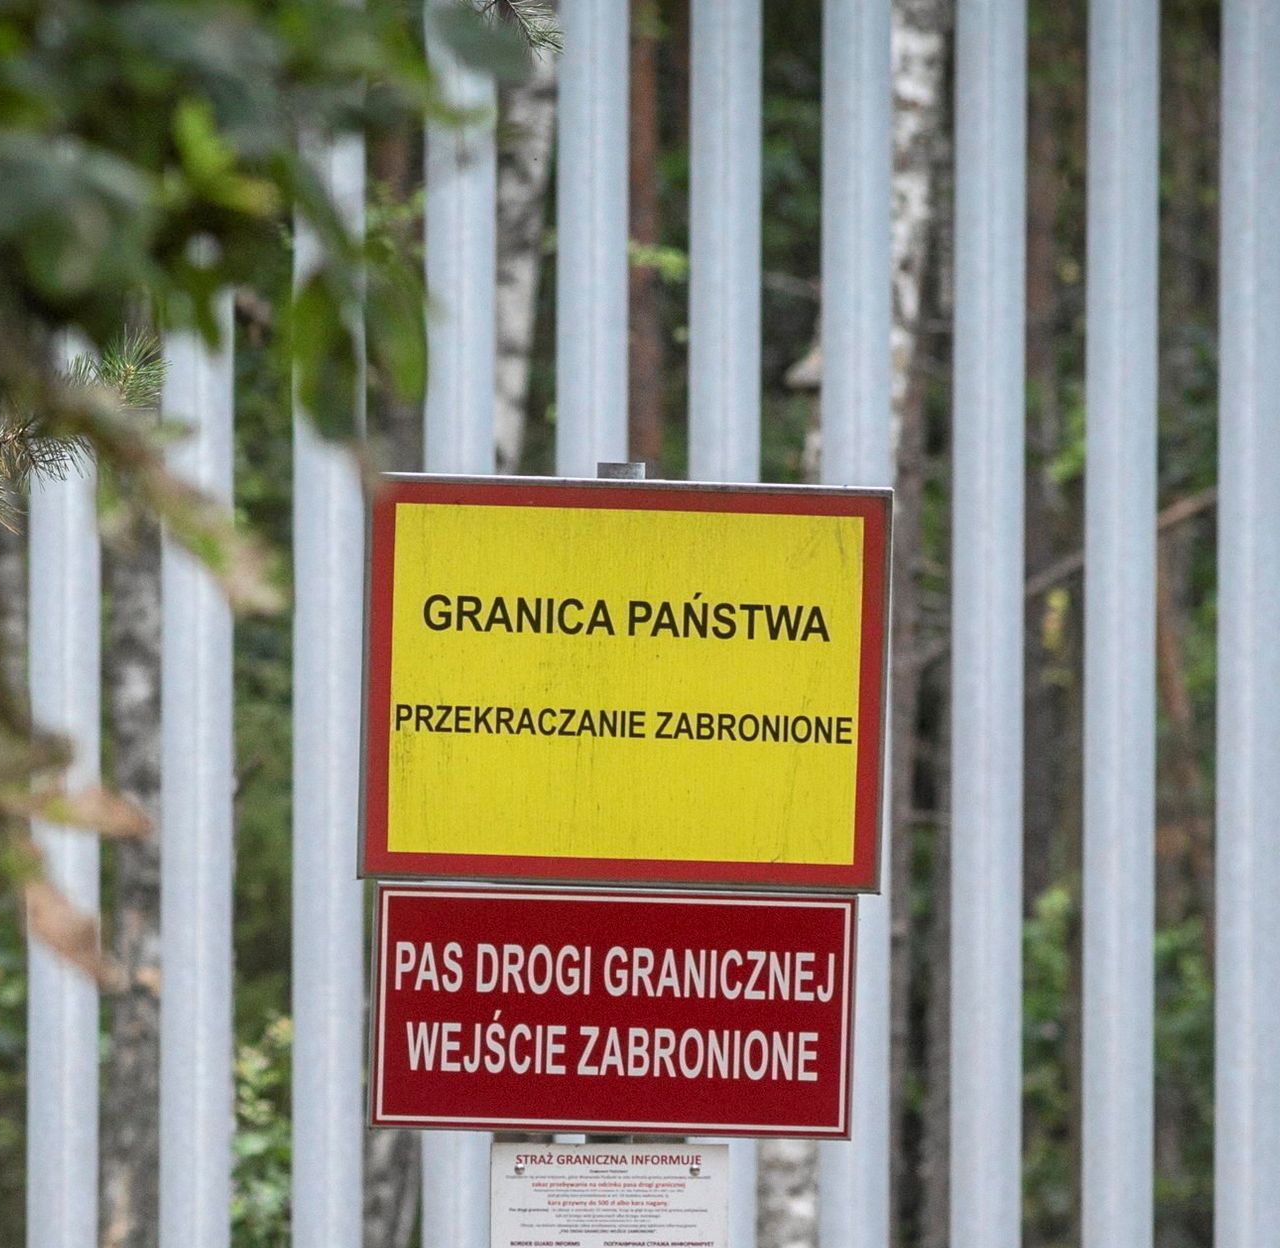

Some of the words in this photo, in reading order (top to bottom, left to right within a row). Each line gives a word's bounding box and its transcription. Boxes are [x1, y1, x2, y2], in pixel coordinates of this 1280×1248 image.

[423, 594, 615, 636] GRANICA
[628, 592, 830, 642] PAŃSTWA
[395, 704, 646, 738] PRZEKRACZANIE
[655, 711, 853, 745] ZABRONIONE
[395, 941, 463, 993] PAS
[476, 943, 592, 996] DROGI
[603, 945, 835, 1003] GRANICZNEJ
[406, 1009, 567, 1075] WEJŚCIE
[577, 1025, 819, 1082] ZABRONIONE
[516, 1152, 554, 1165] STRAŻ
[556, 1154, 628, 1166] GRANICZNA
[631, 1154, 702, 1166] INFORMUJE
